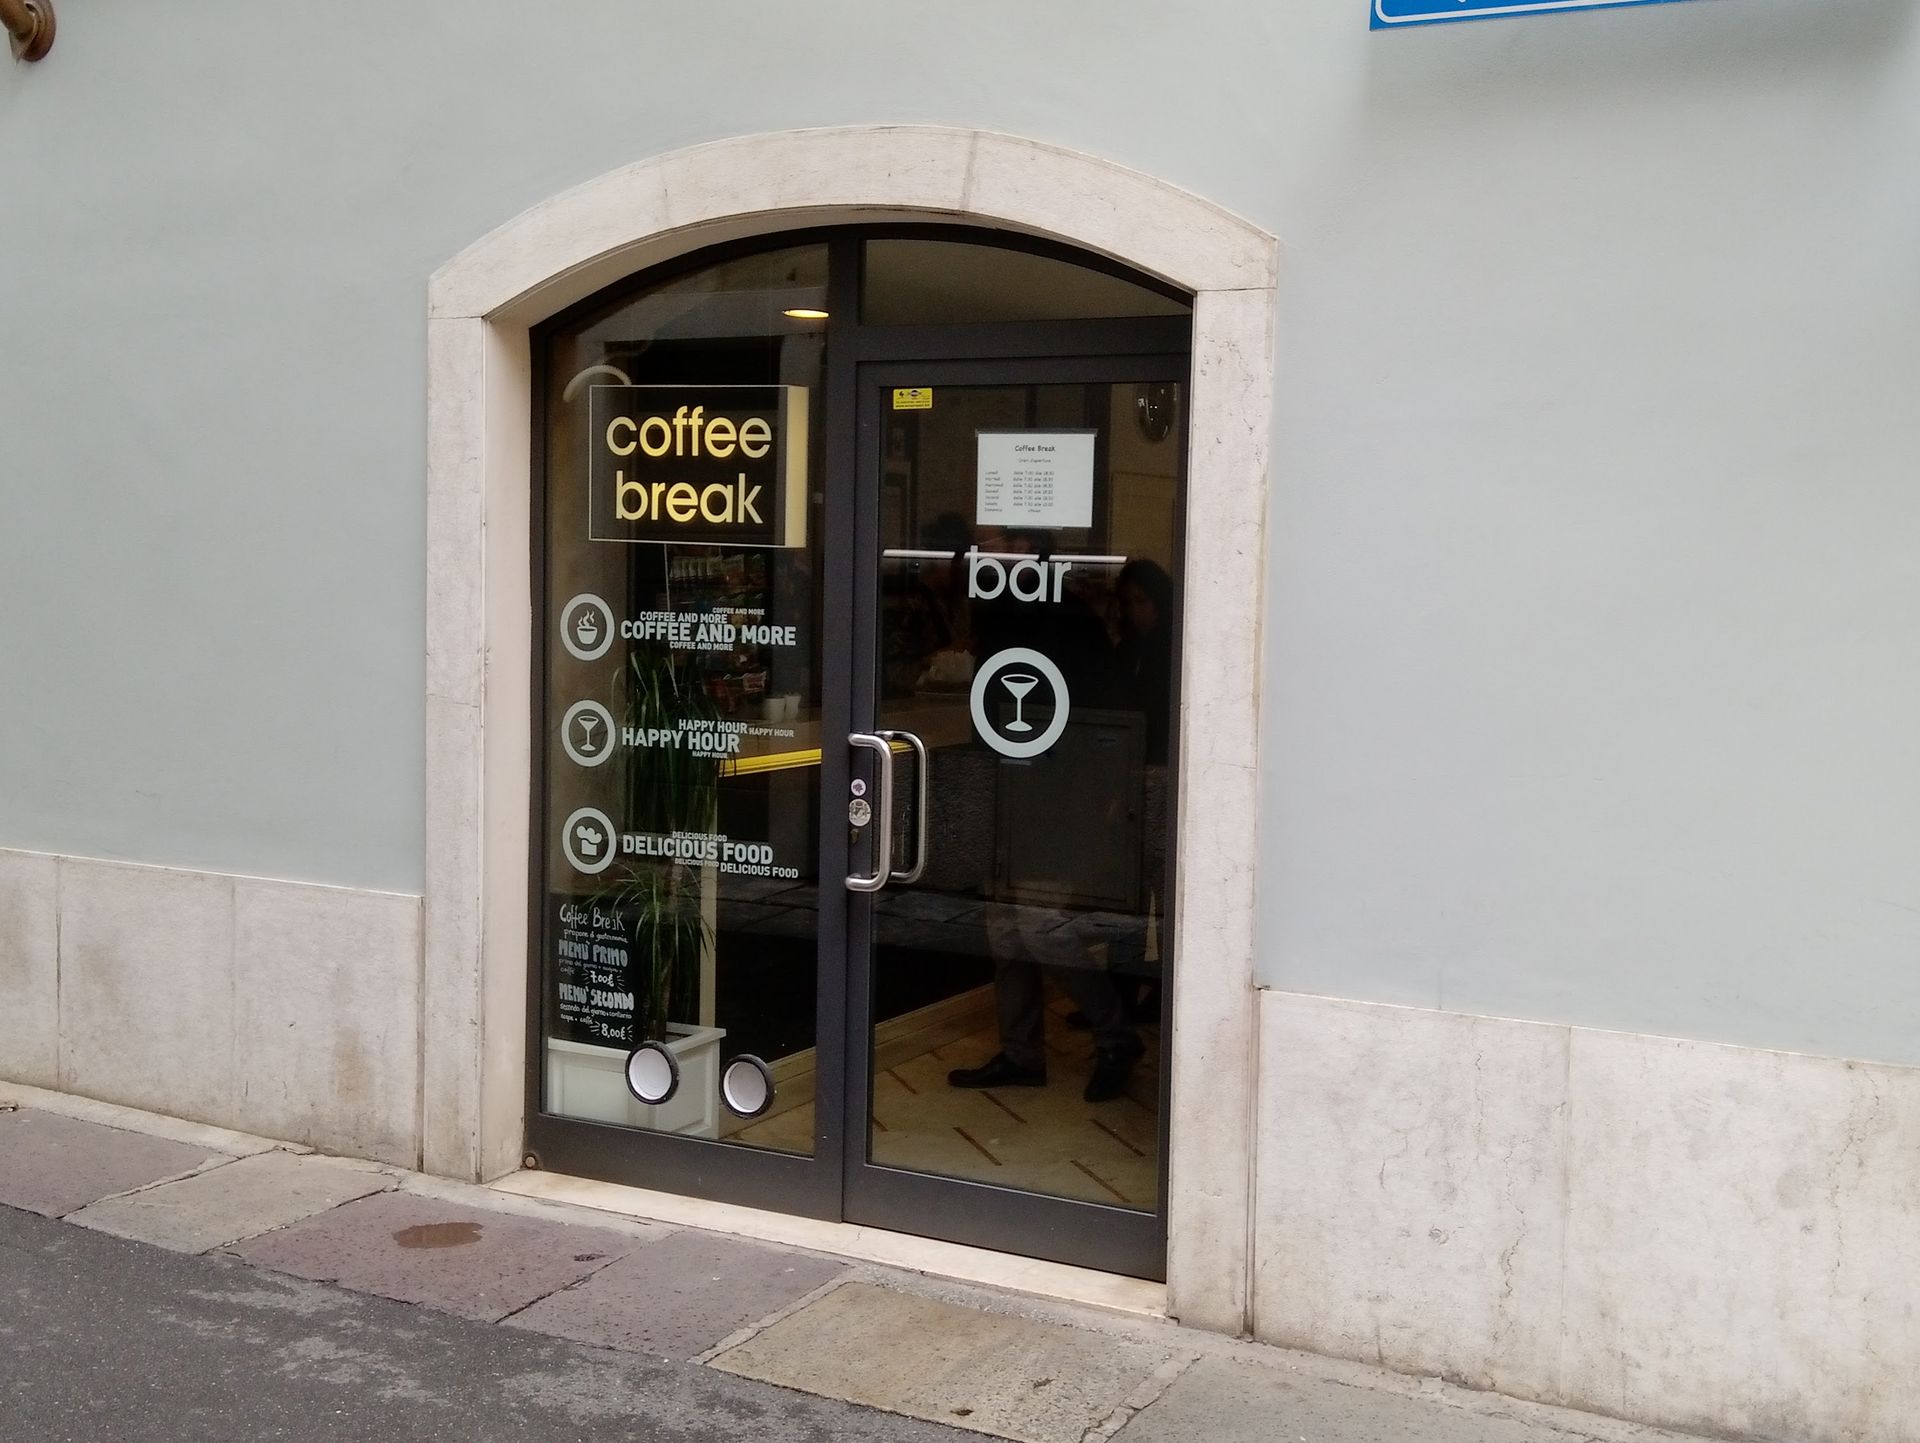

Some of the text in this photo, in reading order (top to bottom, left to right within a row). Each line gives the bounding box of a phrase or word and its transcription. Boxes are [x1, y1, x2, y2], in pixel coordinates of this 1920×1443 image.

[606, 405, 772, 459] coffee
[615, 470, 763, 524] break
[968, 545, 1072, 603] bar
[640, 611, 728, 624] COFFEE AND MORE
[712, 607, 734, 615] COFFEE
[748, 608, 765, 616] MORE
[620, 620, 797, 646] COFFEE AND MORE
[669, 641, 734, 651] COFFEE AND MORE
[678, 719, 748, 734] HAPPY HOUR
[749, 727, 795, 738] HAPPY HOUR
[621, 727, 740, 753] HAPPY HOUR
[692, 750, 728, 759] HAPPY HOUR
[672, 831, 728, 842] DELICIOUS FOOD
[622, 834, 774, 865] DELICIOUS FOOD
[674, 858, 719, 868] DELICIOUS FOOD
[720, 862, 799, 879] DELICIOUS FOOD
[560, 903, 588, 929] Coffee
[592, 944, 629, 968] PRIMO
[590, 988, 635, 1011] SECONDO
